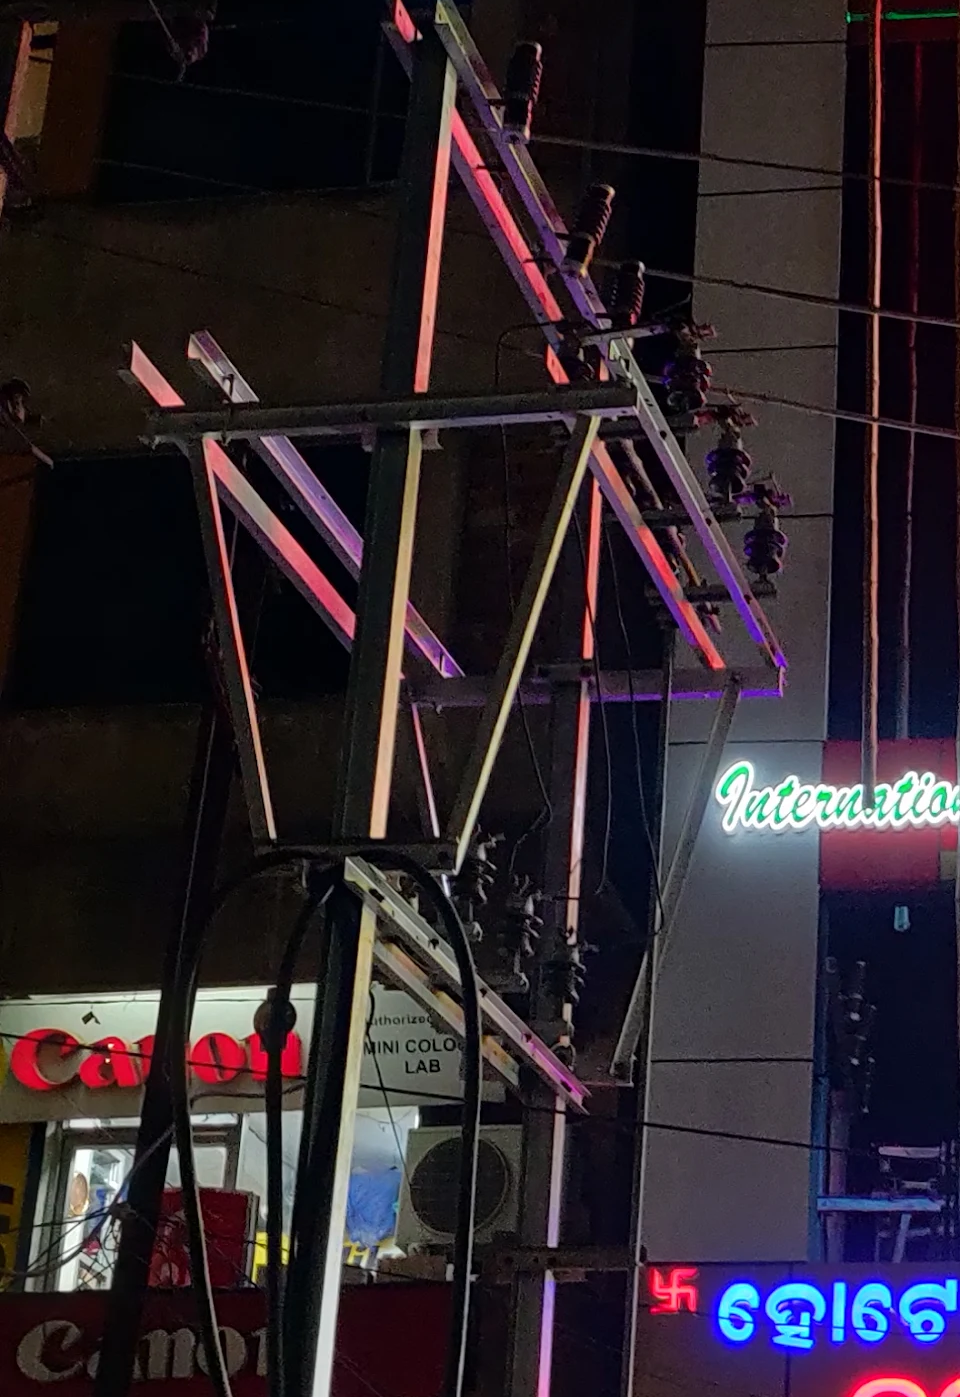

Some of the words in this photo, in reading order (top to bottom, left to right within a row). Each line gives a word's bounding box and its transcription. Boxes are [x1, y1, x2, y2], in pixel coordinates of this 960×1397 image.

[363, 1040, 399, 1055] MINI
[405, 1037, 463, 1053] COLO
[405, 1059, 441, 1074] LAB
